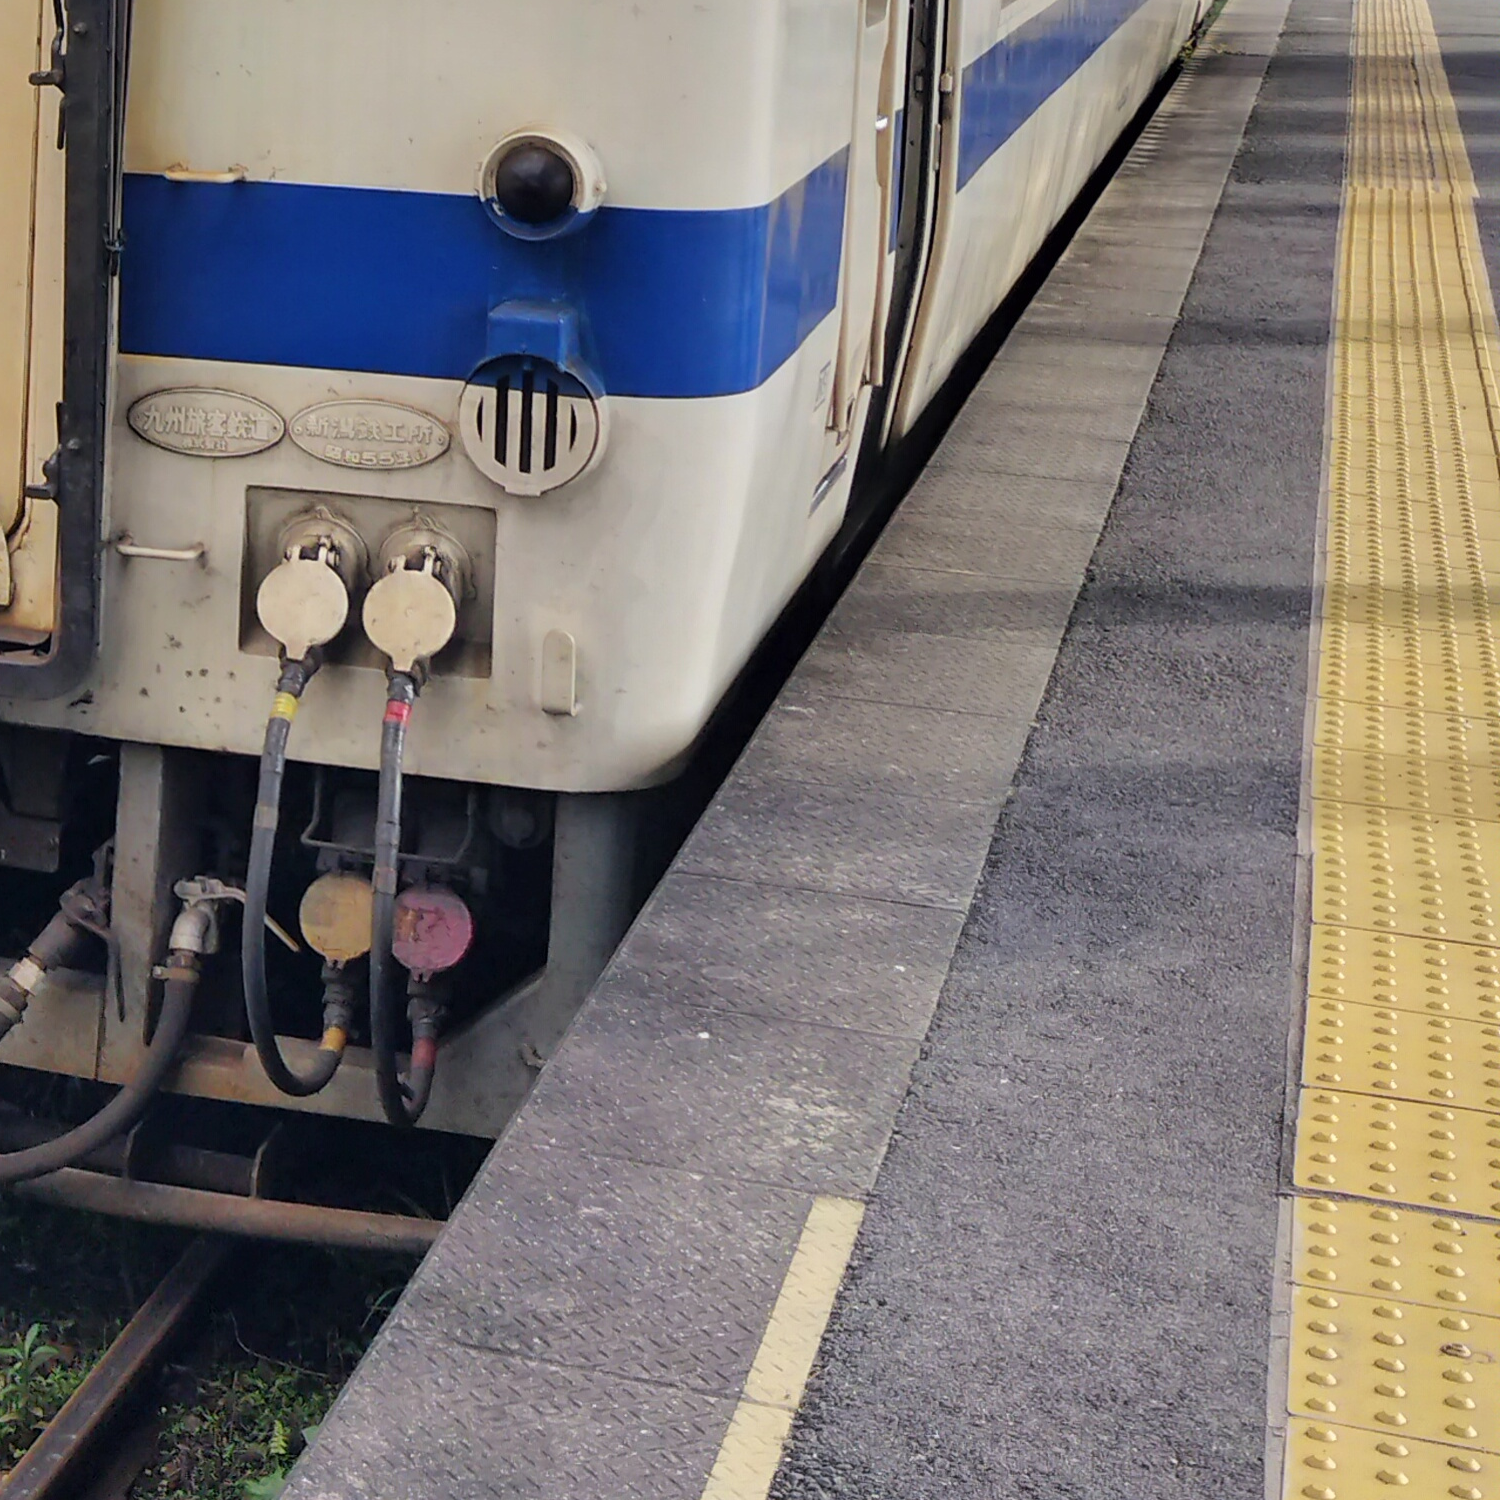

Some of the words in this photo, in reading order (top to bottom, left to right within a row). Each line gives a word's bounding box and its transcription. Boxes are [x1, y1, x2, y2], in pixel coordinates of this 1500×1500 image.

[143, 404, 270, 441] 九州旅客鉄道
